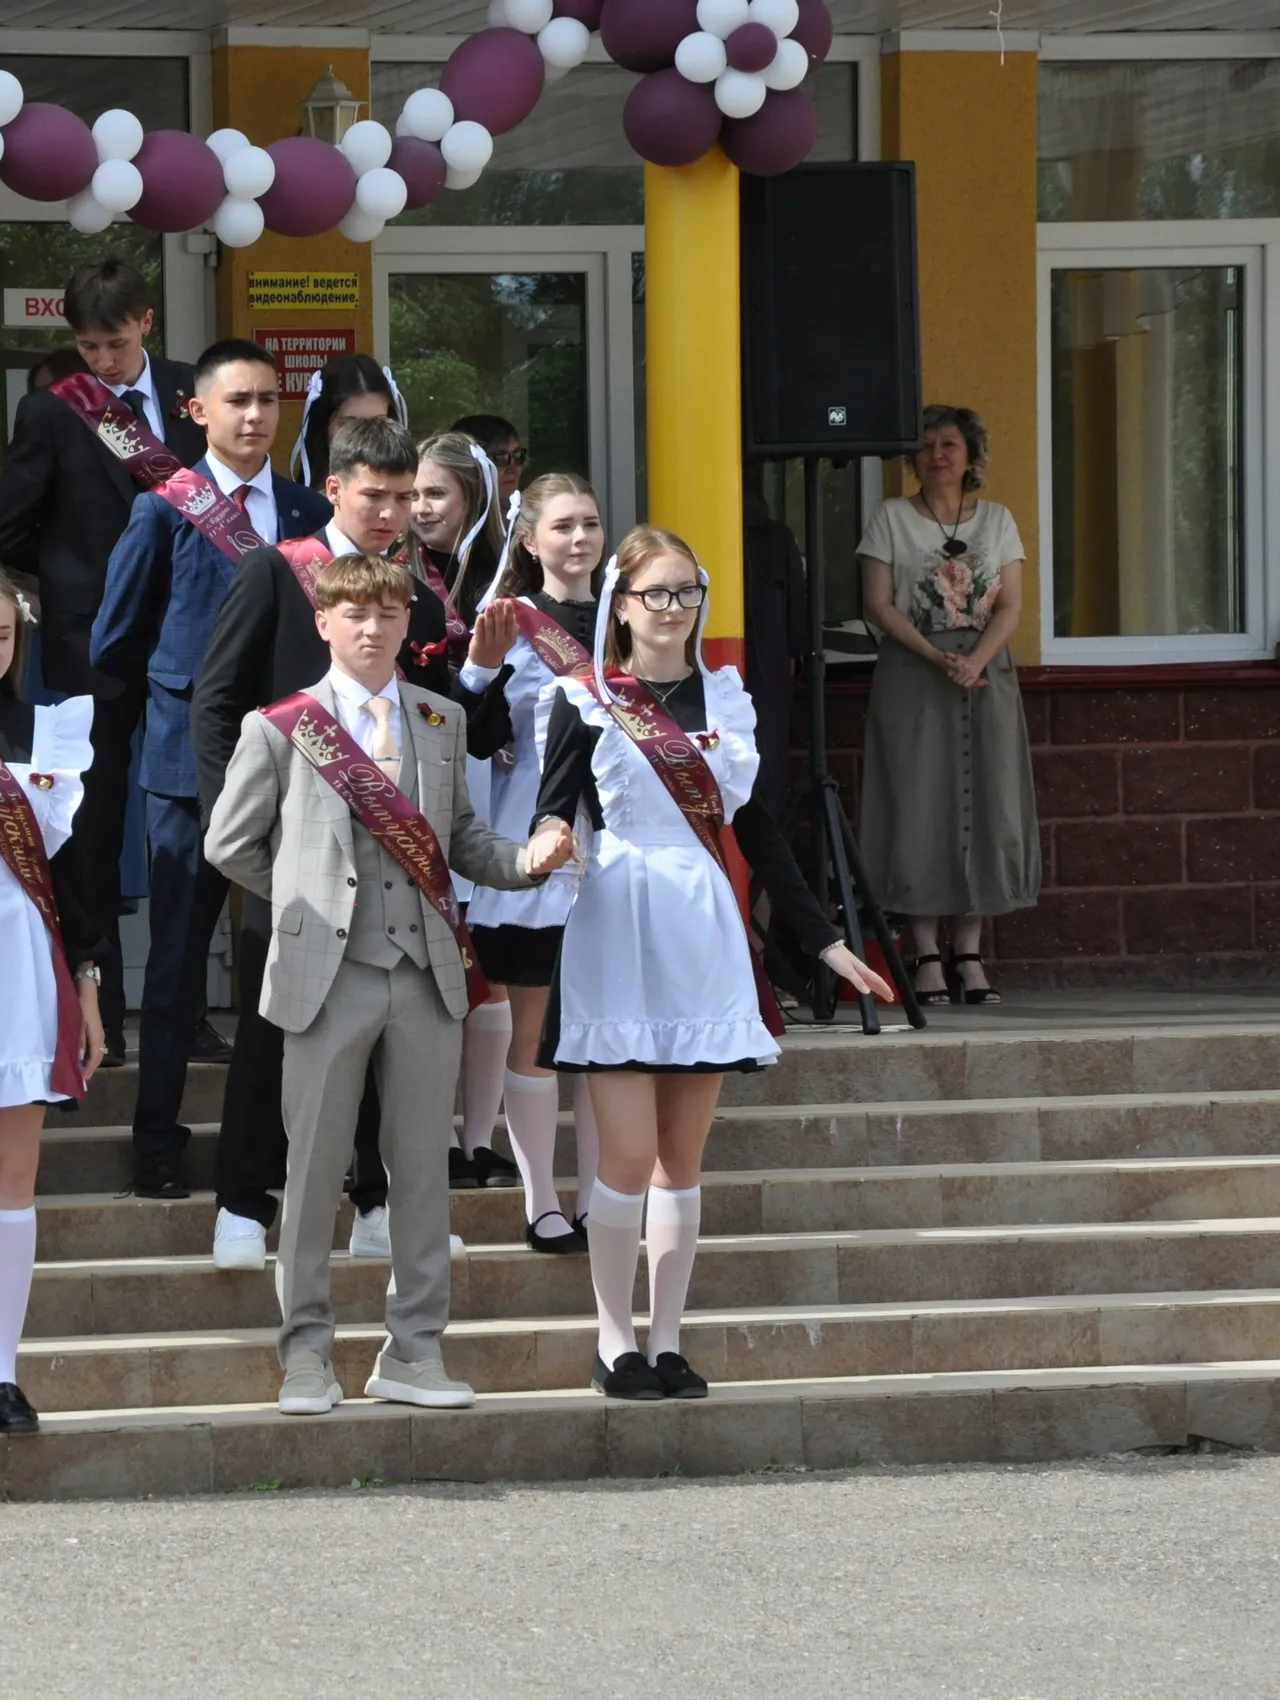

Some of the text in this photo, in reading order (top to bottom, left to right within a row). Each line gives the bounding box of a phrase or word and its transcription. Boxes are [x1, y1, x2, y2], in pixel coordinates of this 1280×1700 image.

[249, 276, 358, 290] внимание! ведется
[249, 290, 359, 305] видеонаблюдение.
[25, 297, 66, 316] ВХО
[265, 337, 346, 351] НА ТЕРРИТОРИИ
[285, 354, 327, 369] ШКОЛЫ
